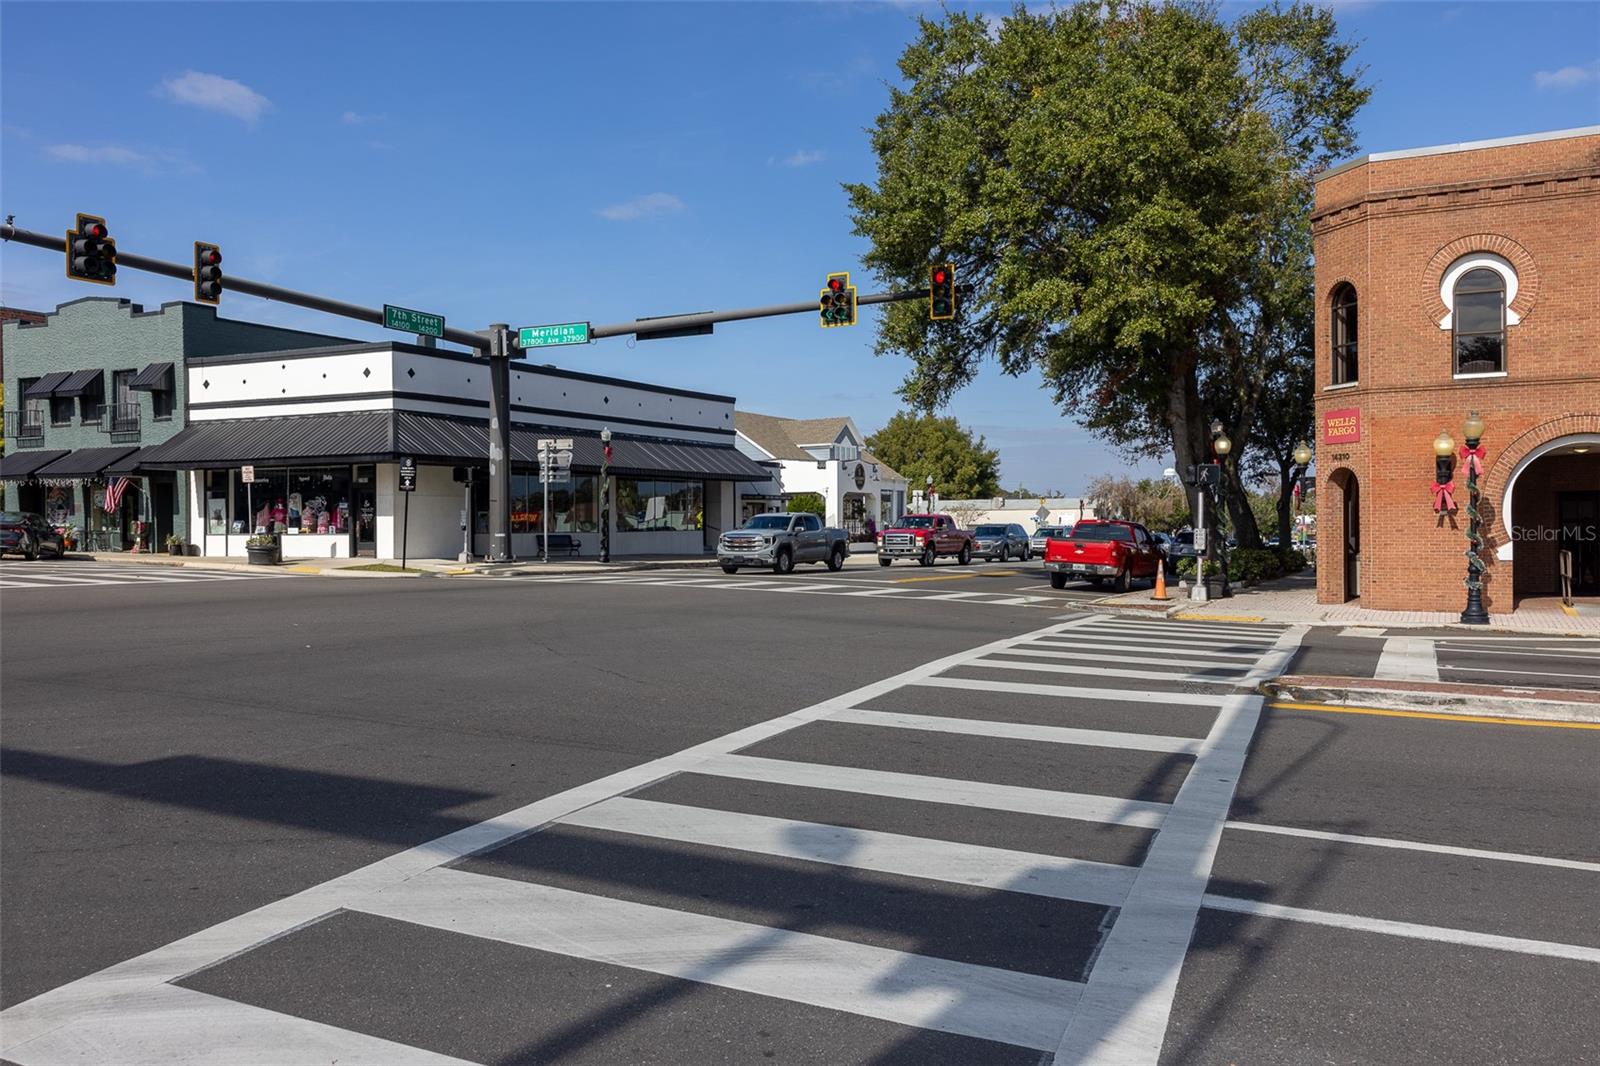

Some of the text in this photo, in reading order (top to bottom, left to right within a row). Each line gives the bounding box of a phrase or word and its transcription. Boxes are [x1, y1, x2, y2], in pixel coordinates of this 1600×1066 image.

[392, 309, 438, 327] 7th Street
[418, 325, 437, 334] 14200
[532, 328, 575, 337] Meridian
[522, 337, 544, 346] 37800
[562, 334, 585, 342] 37900
[1327, 416, 1357, 428] WELLS
[1328, 426, 1356, 436] FARGO
